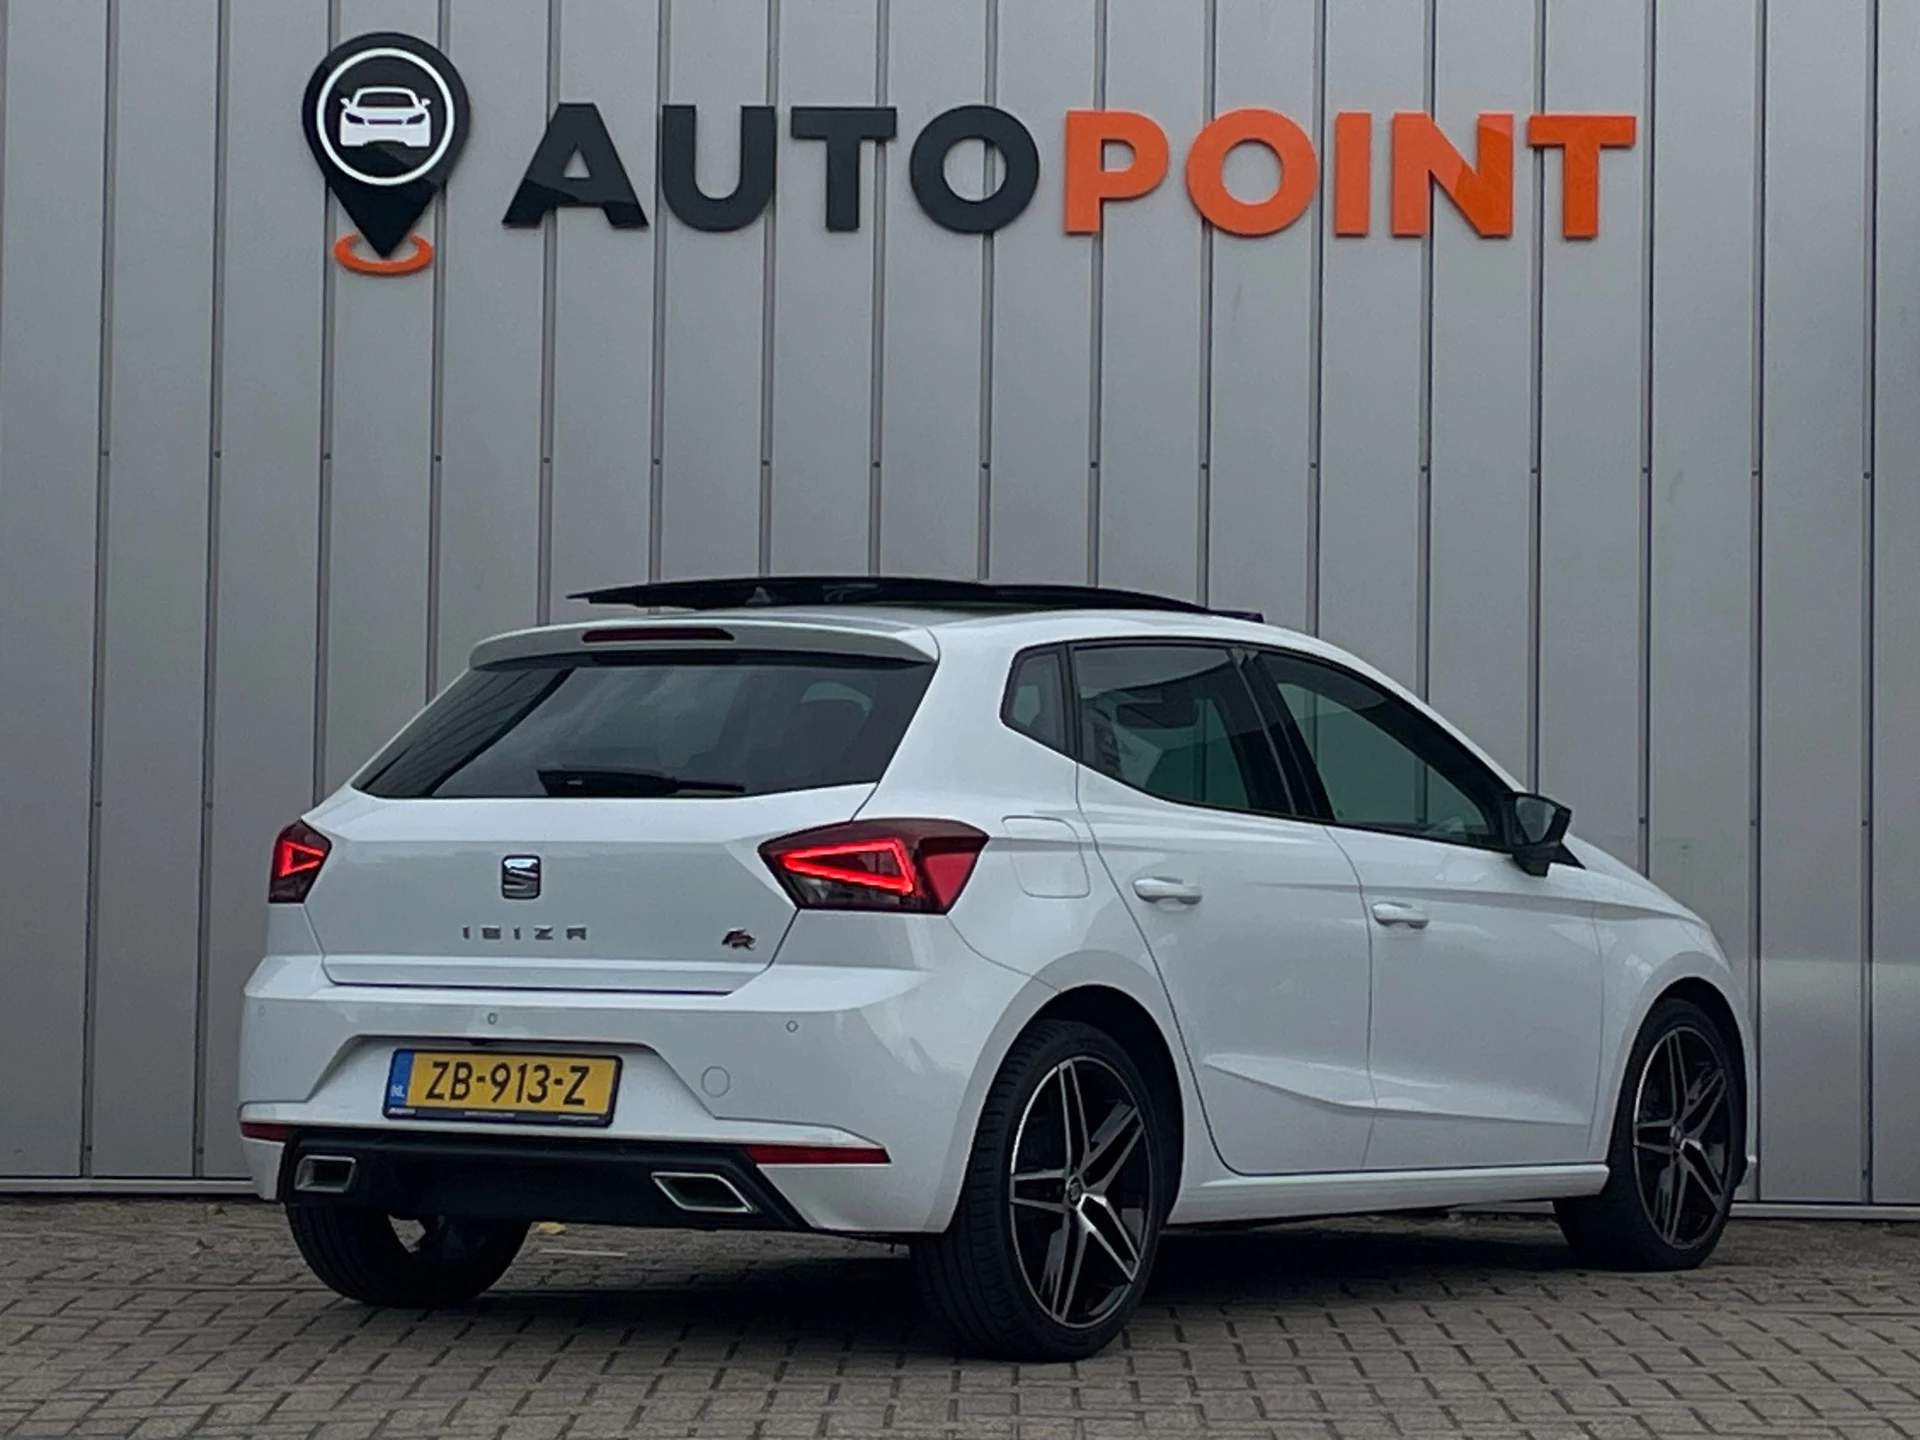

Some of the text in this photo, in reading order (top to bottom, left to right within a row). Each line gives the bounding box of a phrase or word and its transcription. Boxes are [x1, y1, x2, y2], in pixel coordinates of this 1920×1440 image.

[502, 102, 1637, 238] AUTOPOINT
[461, 925, 588, 941] IBIZA
[425, 1061, 590, 1106] ZB-913-Z
